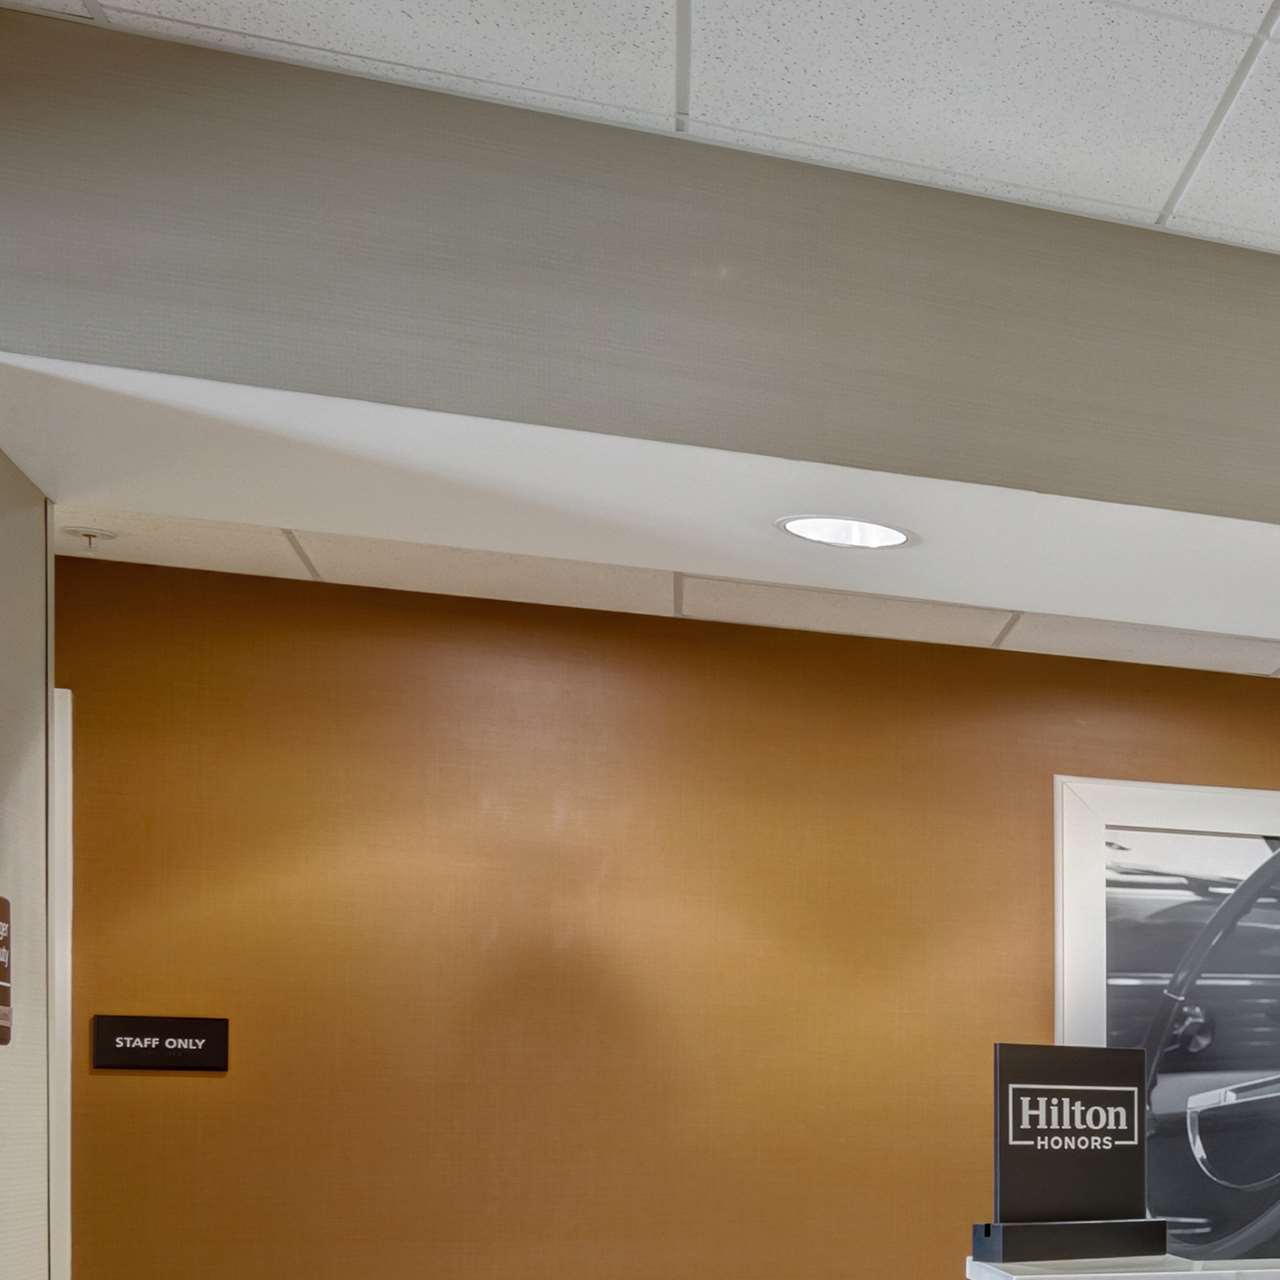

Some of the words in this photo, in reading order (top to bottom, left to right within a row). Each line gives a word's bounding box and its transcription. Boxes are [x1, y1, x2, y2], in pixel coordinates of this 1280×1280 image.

[115, 1036, 160, 1049] STAFF
[164, 1037, 207, 1050] ONLY
[1020, 1097, 1128, 1130] Hilton
[1037, 1135, 1113, 1150] HONORS
